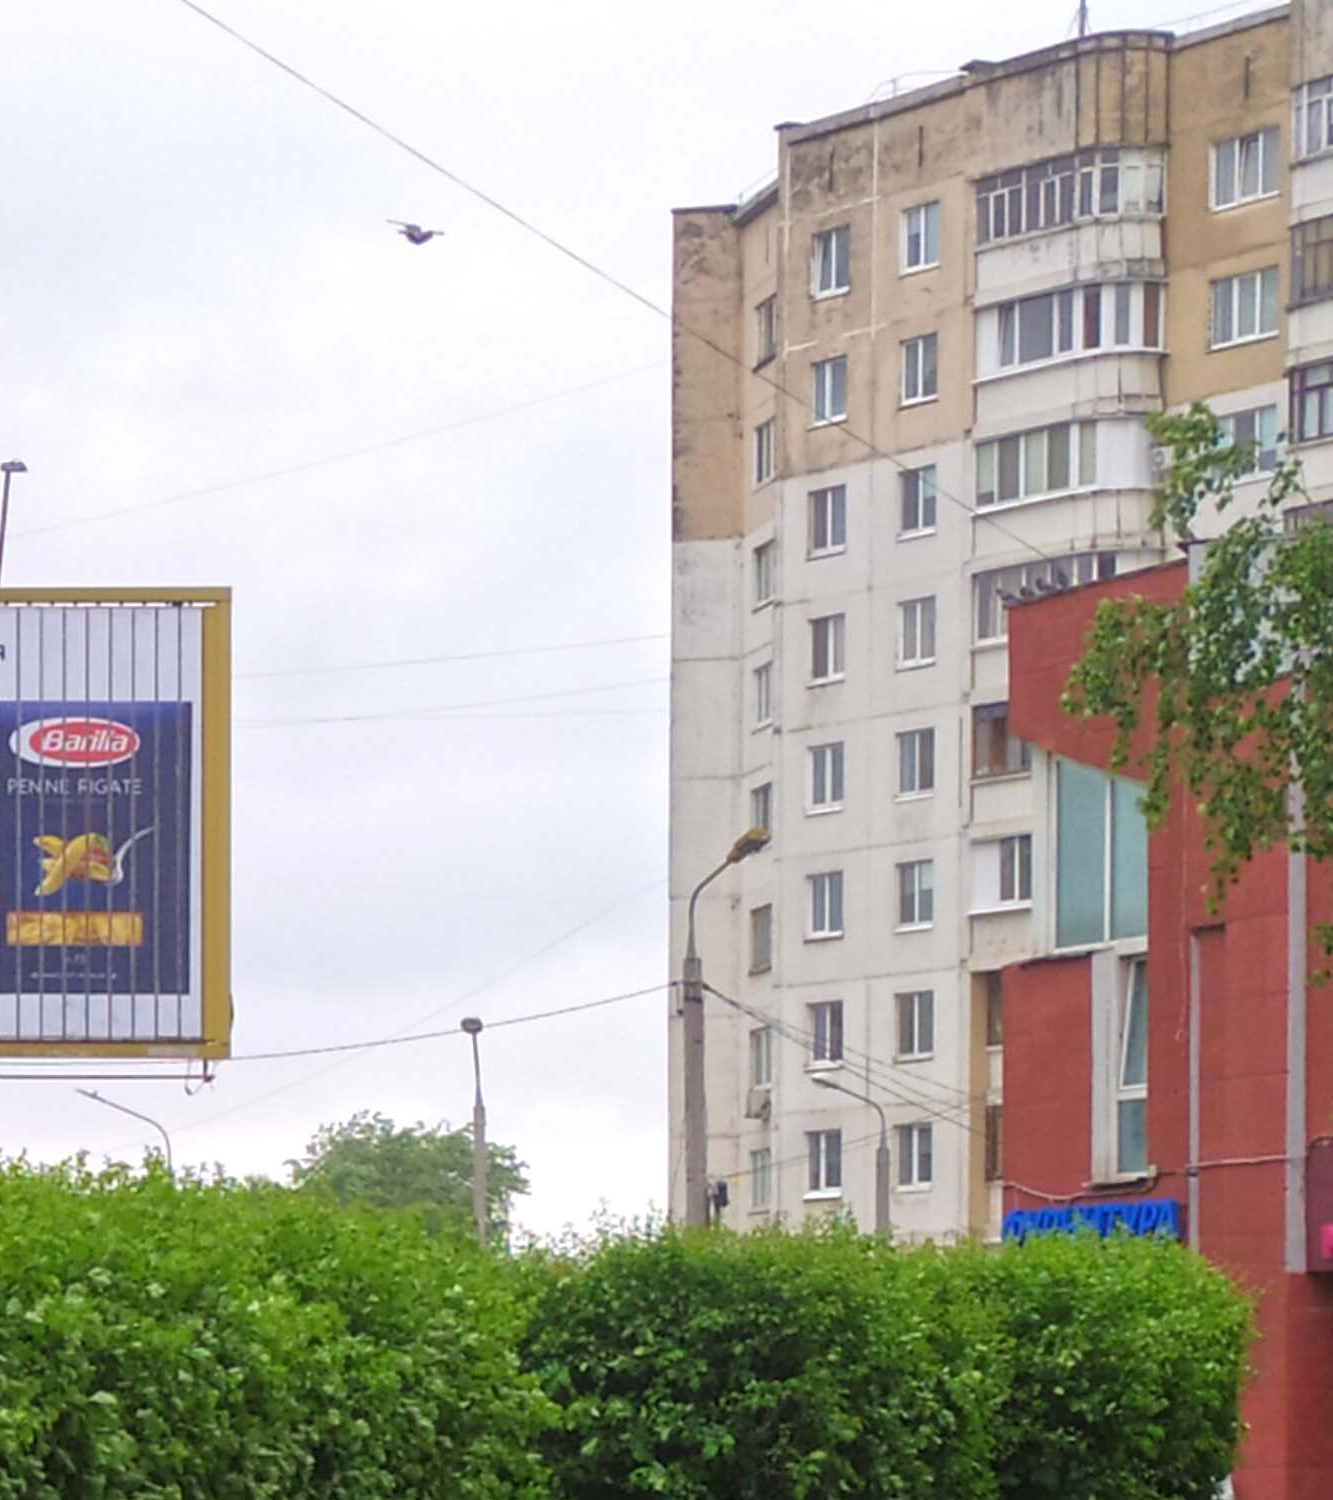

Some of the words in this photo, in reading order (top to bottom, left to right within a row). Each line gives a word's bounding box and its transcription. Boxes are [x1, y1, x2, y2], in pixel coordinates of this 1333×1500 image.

[41, 729, 129, 753] Barilla
[6, 778, 70, 796] PENNE
[77, 778, 142, 795] RIGATE
